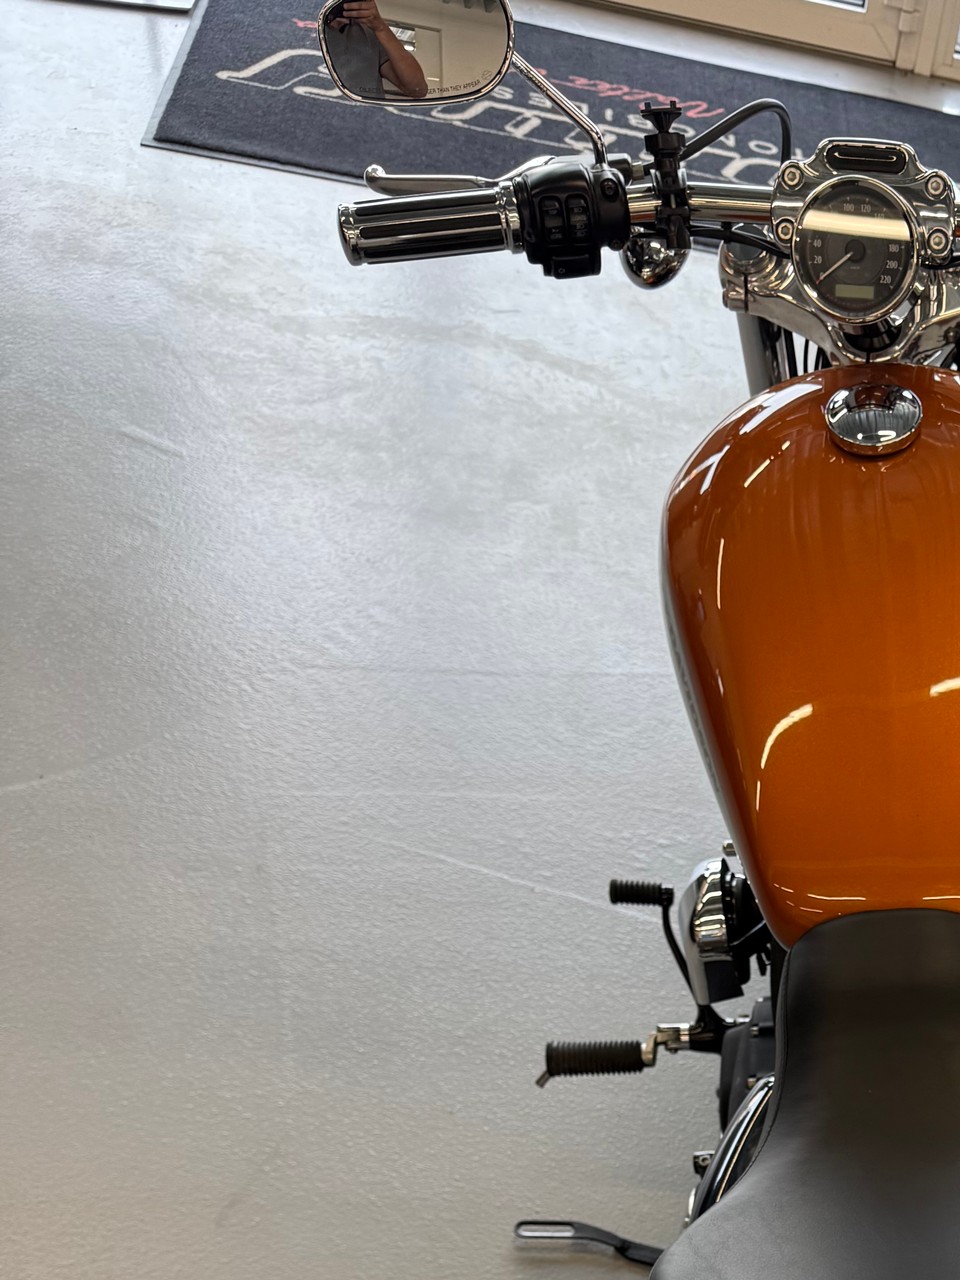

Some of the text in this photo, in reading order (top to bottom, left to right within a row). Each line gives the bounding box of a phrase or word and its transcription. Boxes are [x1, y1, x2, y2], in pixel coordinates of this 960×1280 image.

[463, 80, 481, 89] APPEAR
[860, 204, 872, 213] 120
[813, 255, 823, 264] 20
[886, 260, 898, 269] 200
[879, 275, 892, 284] 220
